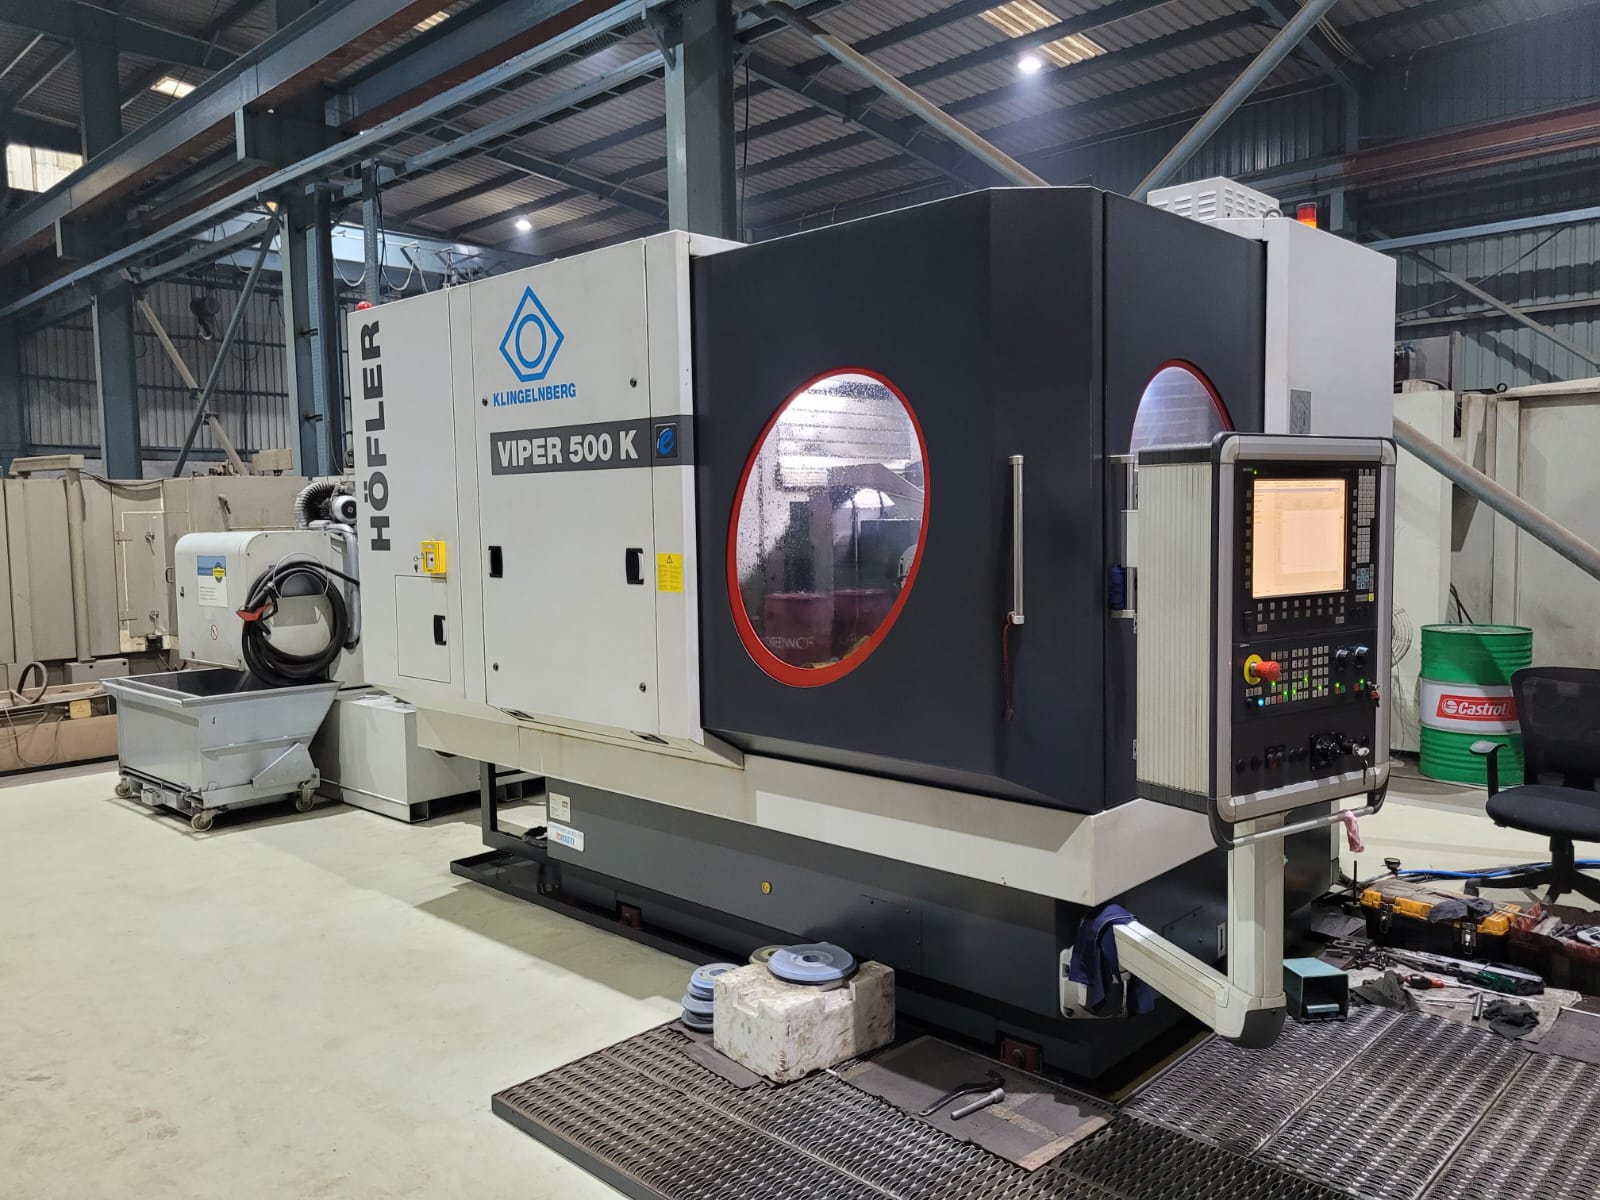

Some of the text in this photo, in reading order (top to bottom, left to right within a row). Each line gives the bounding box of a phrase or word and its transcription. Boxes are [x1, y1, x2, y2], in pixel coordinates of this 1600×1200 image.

[493, 383, 577, 407] KLINGELNBERG
[360, 320, 391, 551] HÖFLER
[497, 429, 639, 467] VIPER 500 K
[1458, 702, 1507, 716] Castrol
